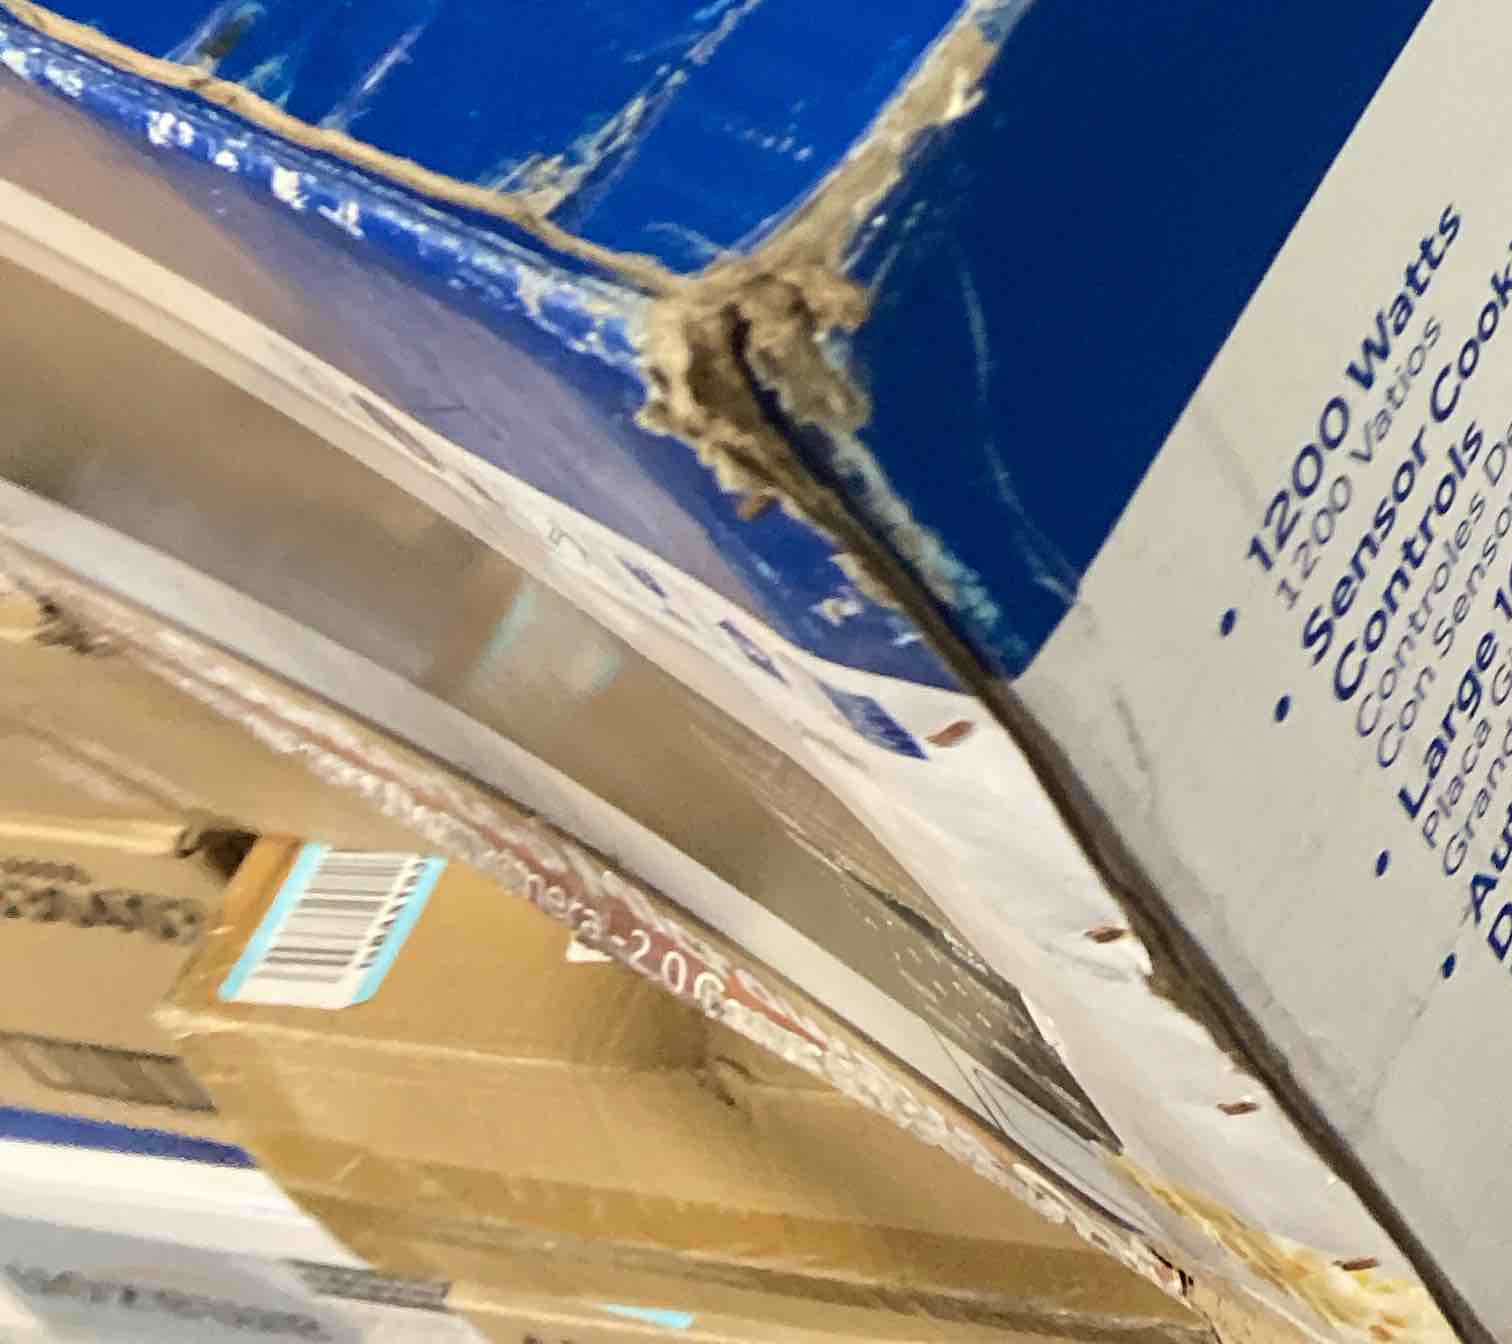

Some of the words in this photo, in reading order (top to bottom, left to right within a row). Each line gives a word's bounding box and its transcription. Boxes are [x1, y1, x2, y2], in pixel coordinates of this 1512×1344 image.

[1248, 397, 1349, 570] 1200
[1346, 206, 1460, 389] Watts
[1276, 475, 1351, 609] 1200
[1348, 317, 1440, 463] Vatios
[1302, 427, 1425, 664] Sensor
[1333, 423, 1482, 700] Controls
[1355, 493, 1485, 737] Controles
[1376, 666, 1434, 768] Con
[1398, 632, 1497, 818] Large
[1421, 706, 1491, 848] Placa
